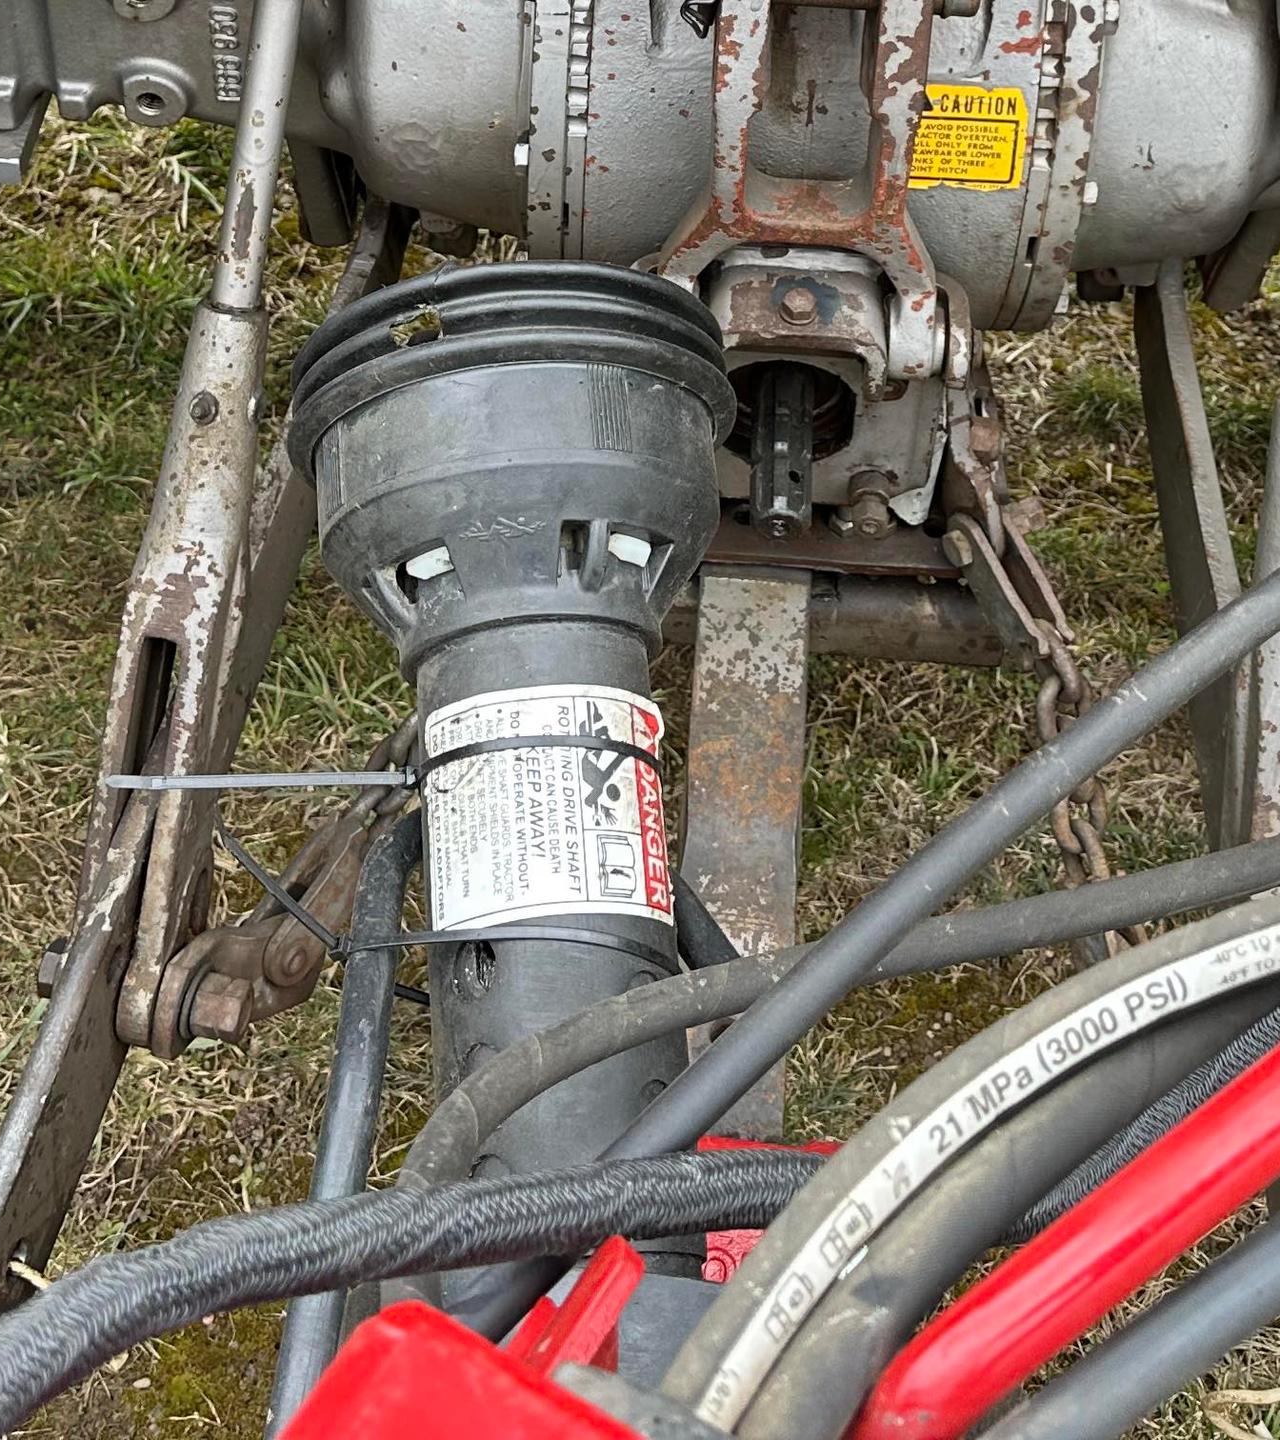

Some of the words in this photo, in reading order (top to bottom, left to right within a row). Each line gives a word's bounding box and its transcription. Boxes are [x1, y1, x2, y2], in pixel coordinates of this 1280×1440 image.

[940, 95, 1017, 115] CAUTION
[915, 132, 951, 140] RACTOR
[956, 125, 999, 133] POSSIBLE
[971, 151, 1001, 159] LOWER
[508, 710, 520, 729] DO
[511, 762, 525, 824] OPERATE
[544, 773, 556, 797] CAN
[528, 797, 546, 857] AWAY!
[546, 798, 559, 836] CAUSE
[561, 786, 577, 835] DRIVE
[637, 761, 669, 907] DANGER
[548, 837, 560, 875] DEATH
[565, 840, 581, 894] SHAFT
[491, 861, 502, 896] PLACE
[503, 851, 514, 903] TRACTOR
[929, 1119, 965, 1155] 21
[969, 1062, 1034, 1132] MPa
[1037, 1007, 1120, 1074] (3000
[1125, 970, 1190, 1024] PSI)
